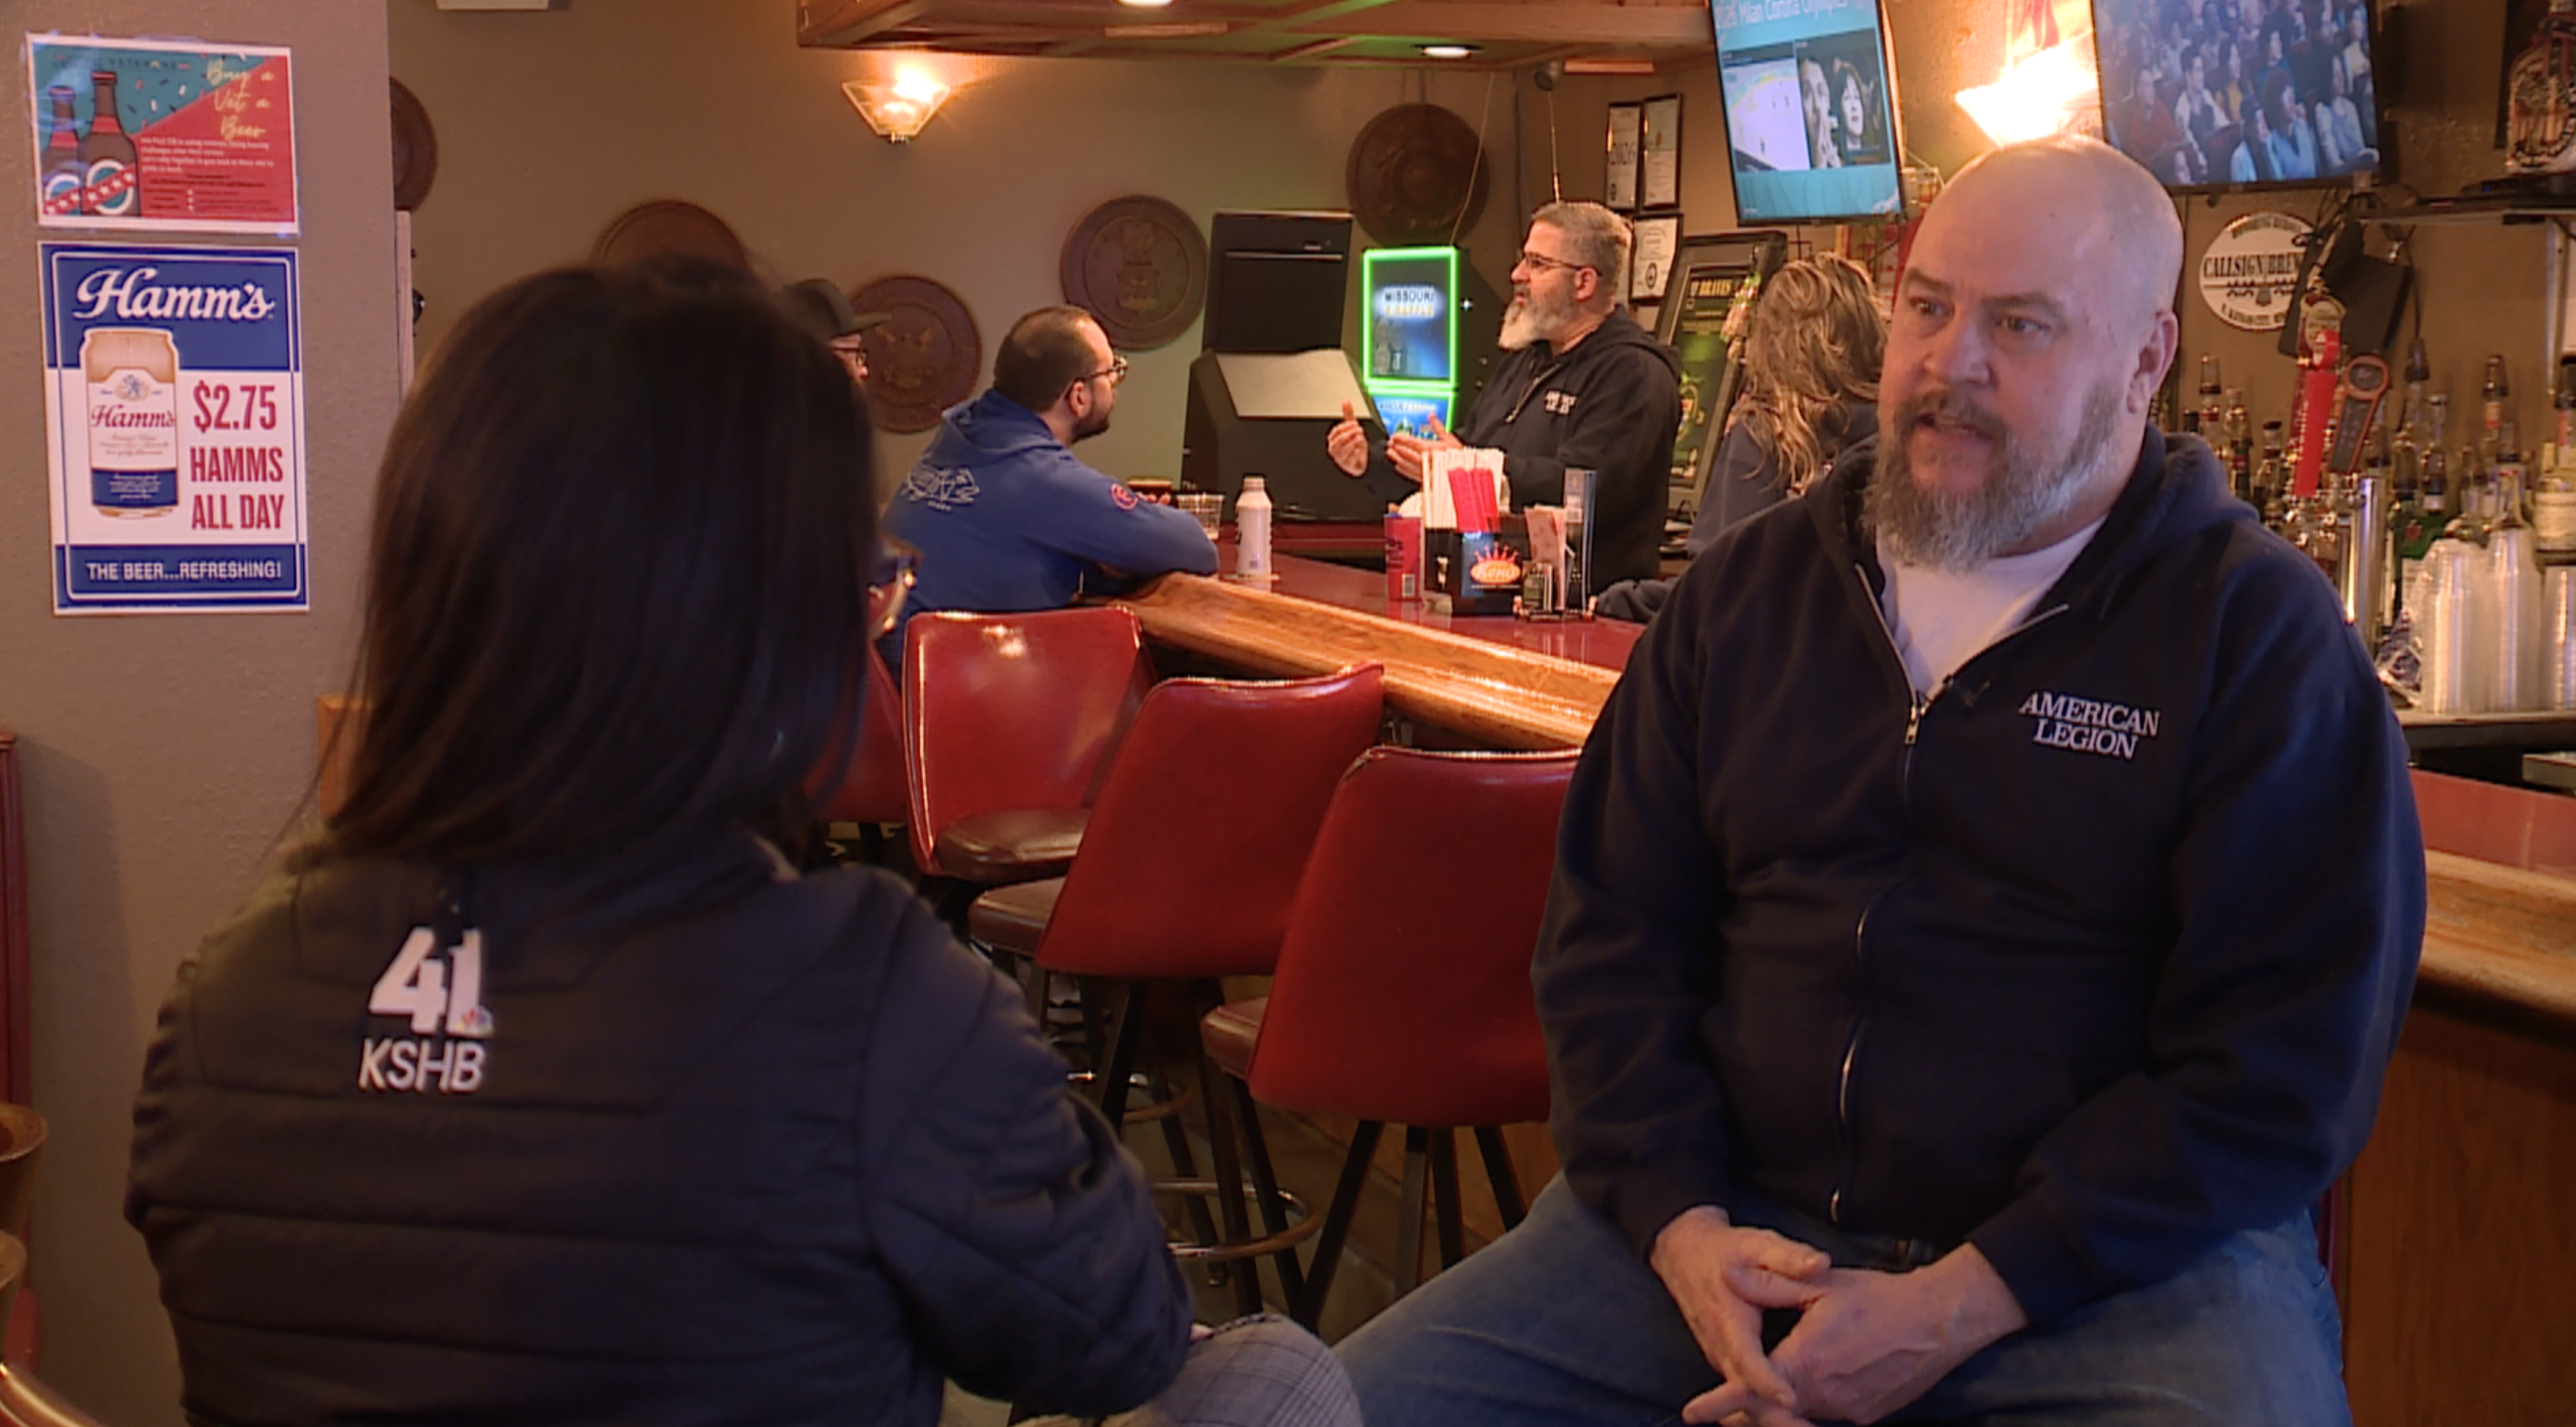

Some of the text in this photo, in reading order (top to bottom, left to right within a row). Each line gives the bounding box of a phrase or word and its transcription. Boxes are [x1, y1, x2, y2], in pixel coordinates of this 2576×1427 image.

[207, 59, 275, 92] Buy a
[214, 88, 270, 113] Vet a
[220, 115, 266, 141] Beer
[2203, 254, 2264, 278] CALLSIGN
[73, 268, 276, 320] Hamm's
[90, 403, 176, 429] Hamm's
[193, 380, 277, 433] $2.75
[189, 446, 284, 483] HAMMS
[191, 494, 285, 530] ALL DAY
[86, 561, 282, 582] THE BEER...REFRESHING!
[2018, 691, 2161, 737] AMERICAN
[2033, 718, 2139, 760] LEGION
[368, 926, 482, 1035] 41
[358, 1037, 485, 1093] KSHB
